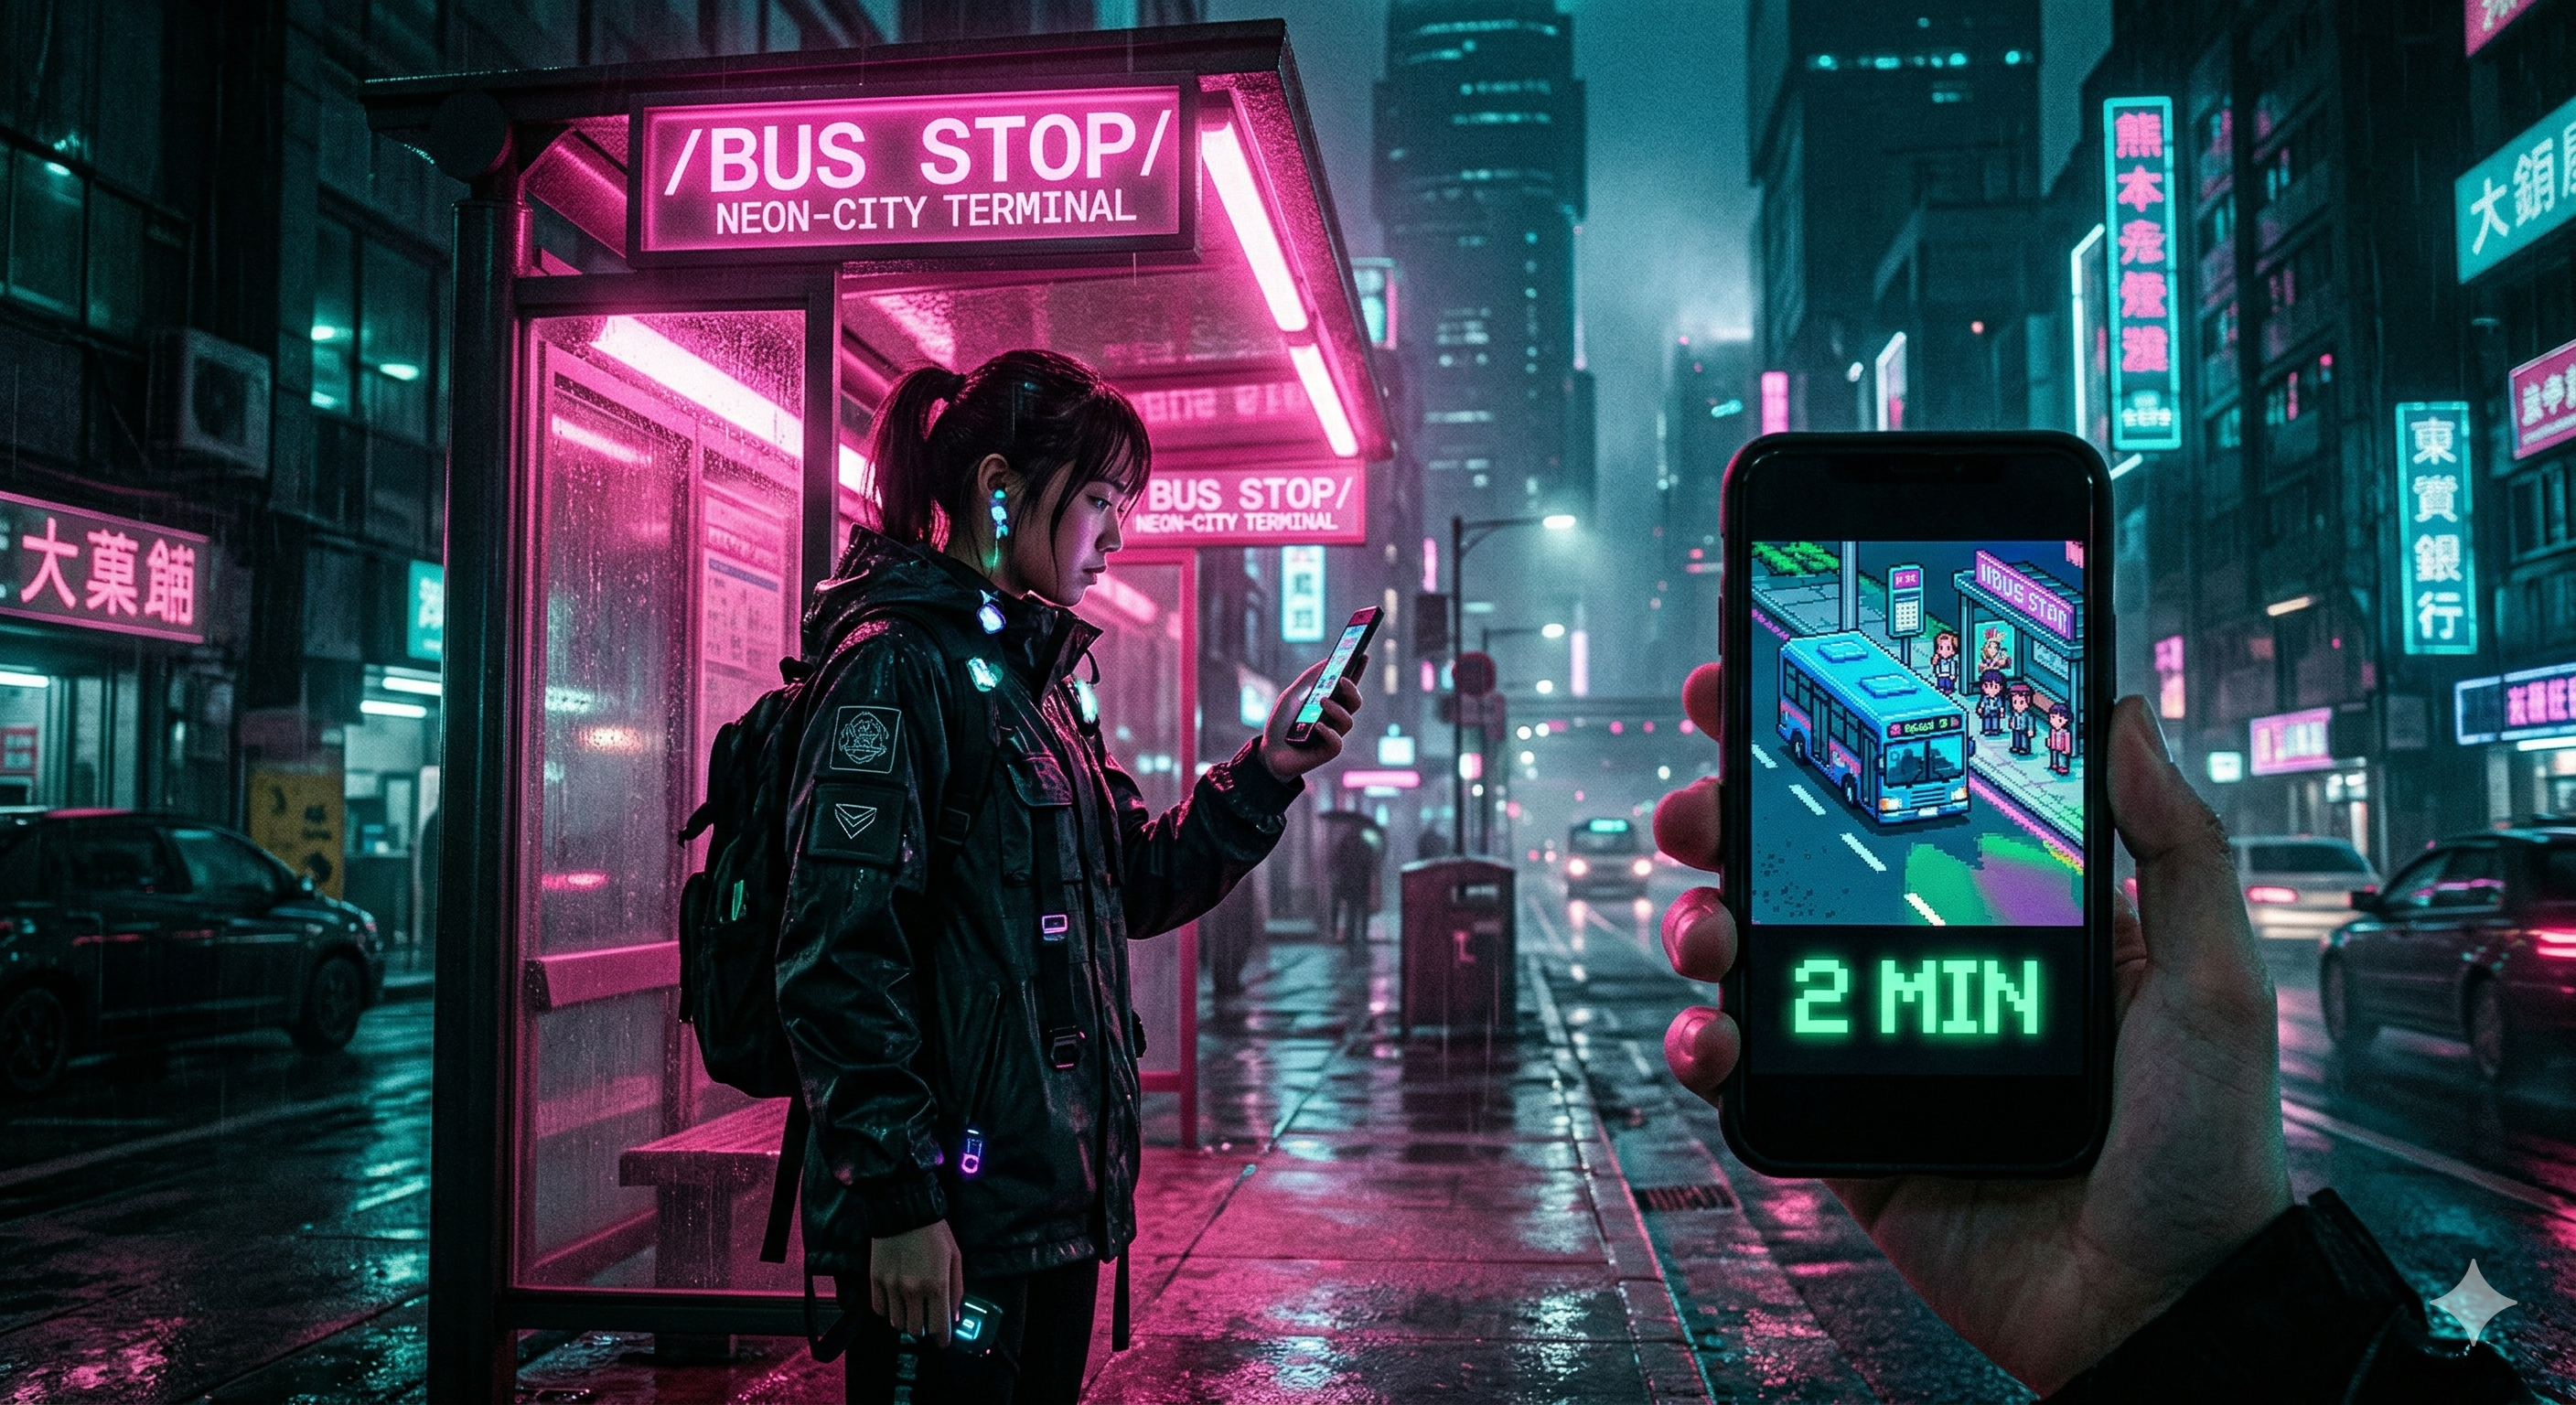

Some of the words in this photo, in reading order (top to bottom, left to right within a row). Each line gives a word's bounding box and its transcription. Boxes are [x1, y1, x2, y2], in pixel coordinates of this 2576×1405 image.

[664, 121, 866, 196] /BUS
[920, 109, 1172, 185] STOP/
[716, 195, 928, 234] NEON-CITY
[943, 188, 1137, 227] TERMINAL
[1149, 478, 1222, 511] BUS
[1239, 476, 1353, 510] STOP/
[1134, 512, 1238, 533] NEON-CITY
[1244, 512, 1338, 532] TERMINAL
[1795, 960, 1848, 1033] 2
[1881, 960, 2037, 1034] MIN
